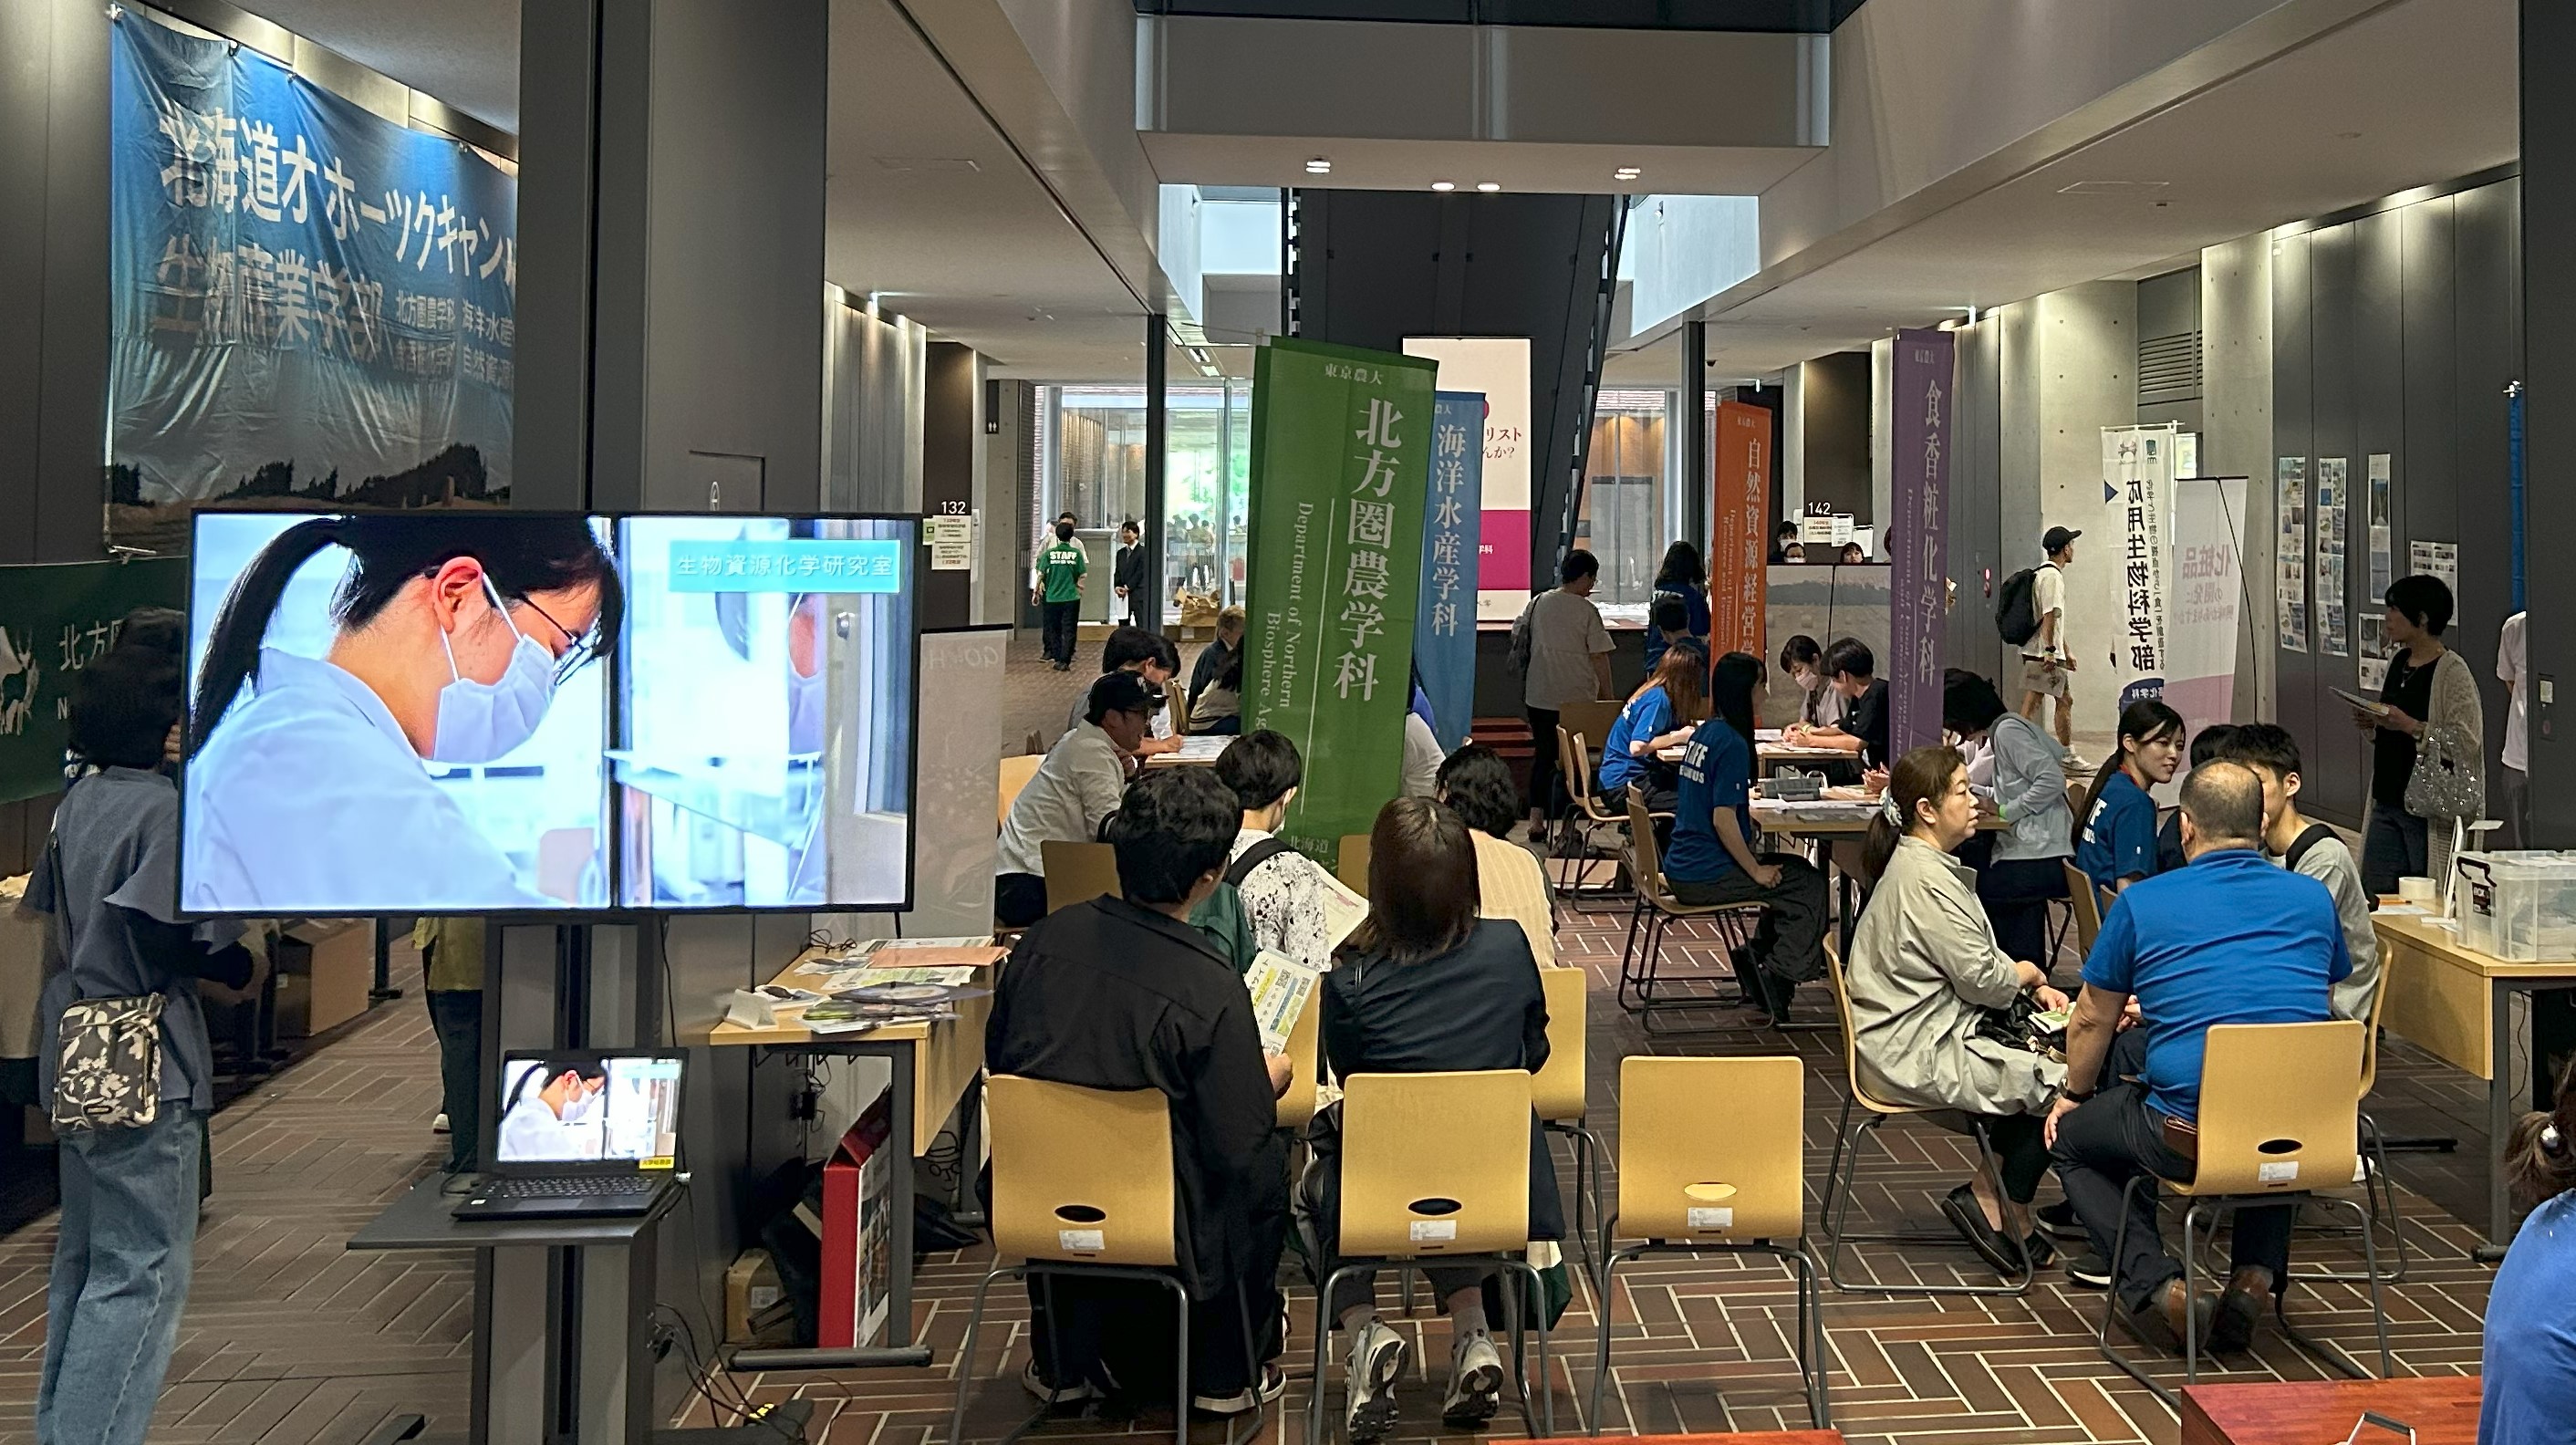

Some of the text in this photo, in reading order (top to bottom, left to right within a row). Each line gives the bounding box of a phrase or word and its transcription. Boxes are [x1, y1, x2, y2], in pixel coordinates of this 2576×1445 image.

[1324, 363, 1383, 385] 東京農大
[940, 501, 966, 515] 132
[1430, 423, 1467, 638] 海洋水産学科
[1808, 502, 1831, 515] 142
[1918, 379, 1942, 687] 食香粧化学科
[677, 554, 894, 577] 生物資源化学研究室
[1049, 551, 1077, 560] STAFF
[1332, 397, 1405, 702] 北方圏農学科
[1279, 502, 1314, 709] Department of Northern
[1259, 612, 1282, 697] Biosphere
